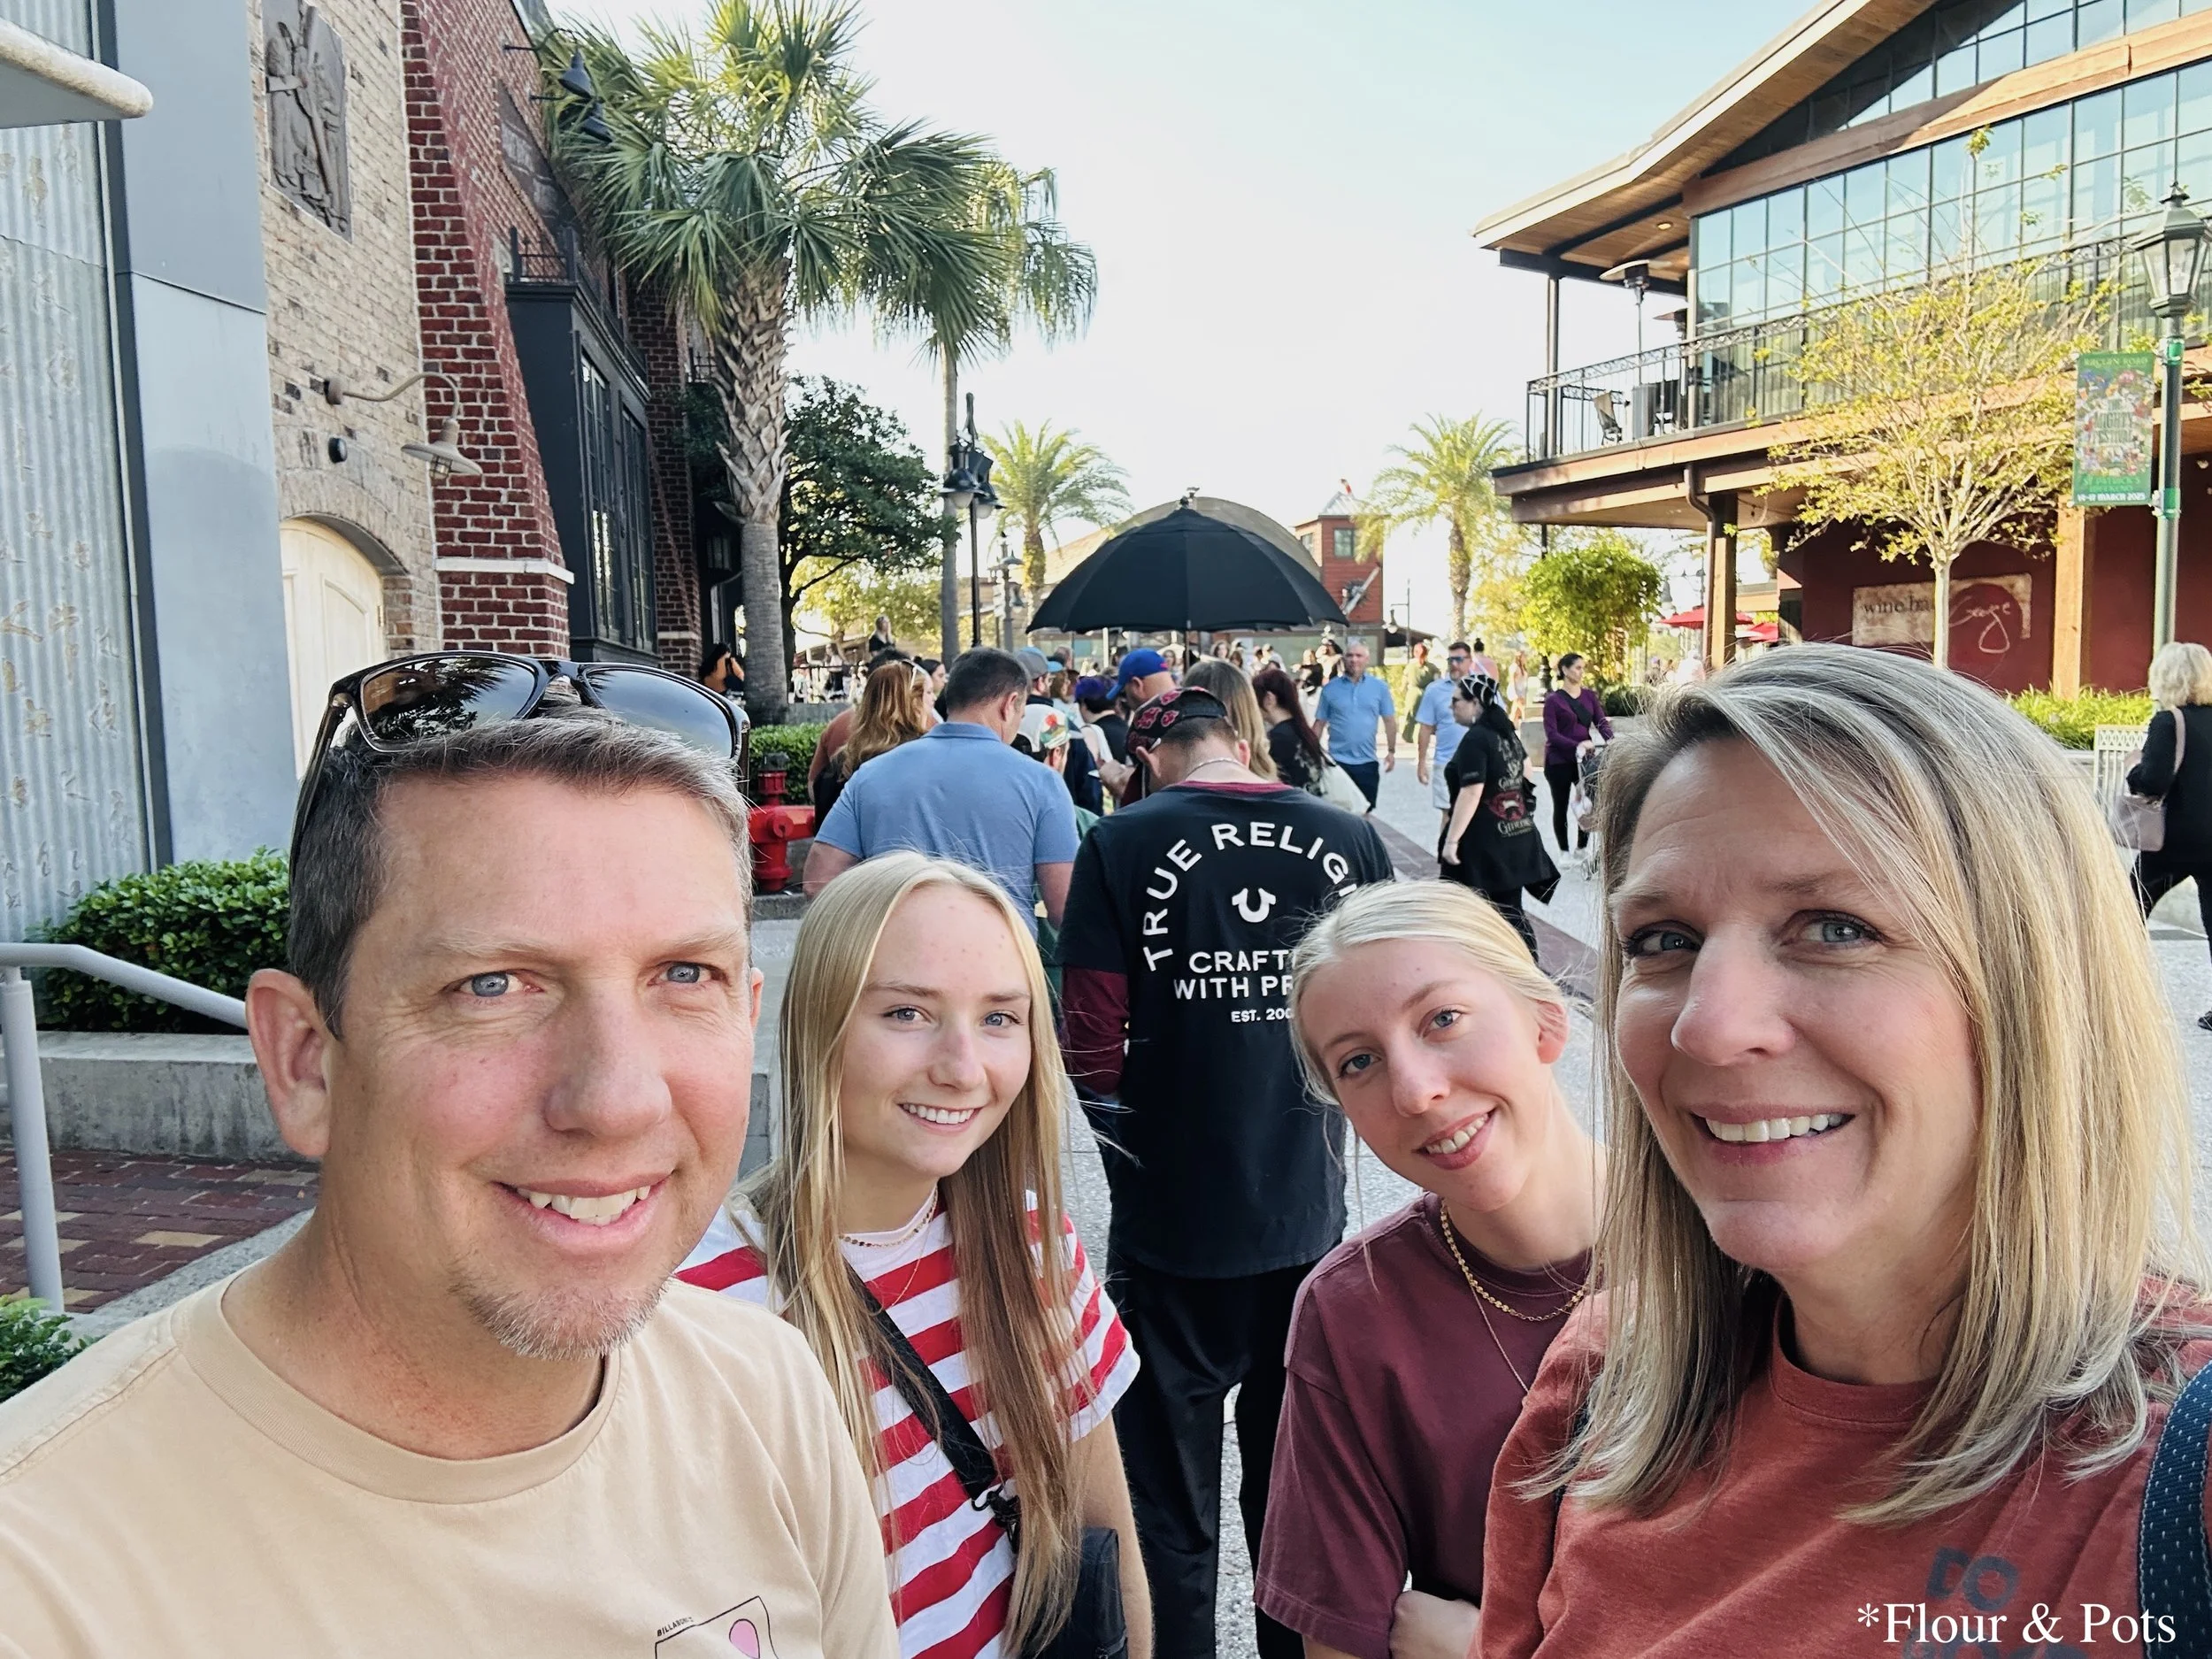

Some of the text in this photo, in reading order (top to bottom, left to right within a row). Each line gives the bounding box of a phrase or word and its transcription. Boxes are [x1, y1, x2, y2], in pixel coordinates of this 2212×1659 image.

[1861, 595, 1932, 613] wine ba
[1142, 821, 1357, 972] TRUE RELIGI
[1188, 949, 1296, 974] CRAFT
[1173, 976, 1249, 1000] WITH
[1231, 1008, 1294, 1023] EST. 200
